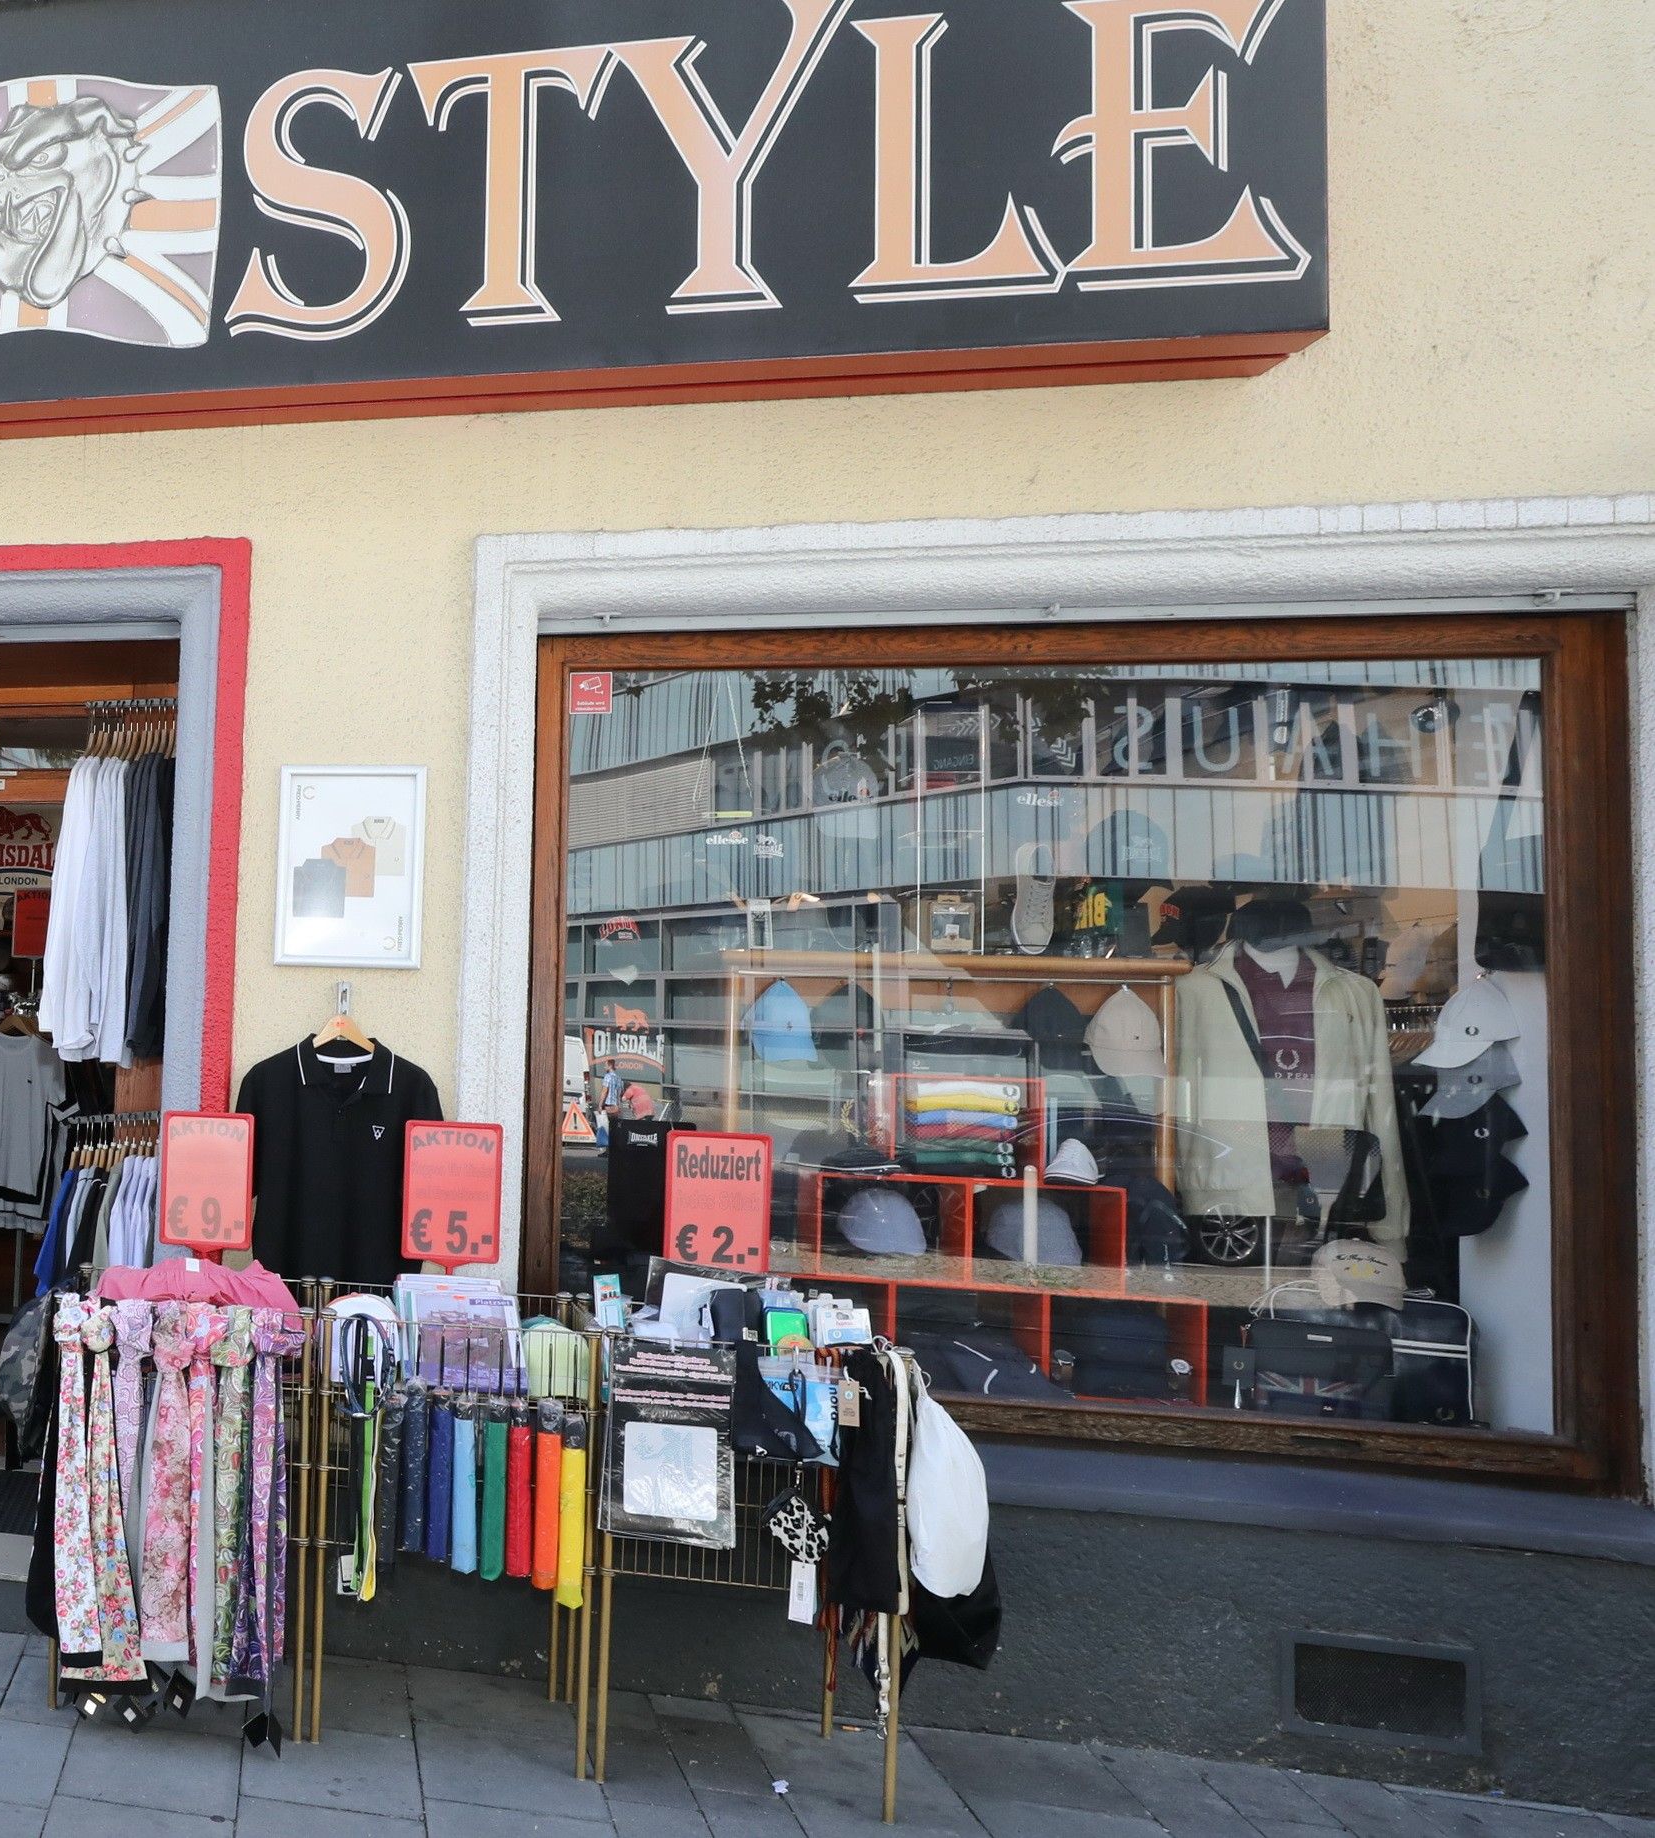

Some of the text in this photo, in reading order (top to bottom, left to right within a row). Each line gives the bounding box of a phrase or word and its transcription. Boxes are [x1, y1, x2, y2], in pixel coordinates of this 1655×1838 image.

[225, 0, 1313, 338] STYLE
[705, 834, 749, 845] ellesse
[170, 1119, 245, 1142] AKTION
[412, 1131, 495, 1154] AKTION
[676, 1144, 761, 1182] Reduziert
[167, 1195, 245, 1240] € 9.-
[410, 1208, 493, 1255] € 5.-
[675, 1224, 759, 1264] € 2.-
[472, 1299, 514, 1307] Platzset
